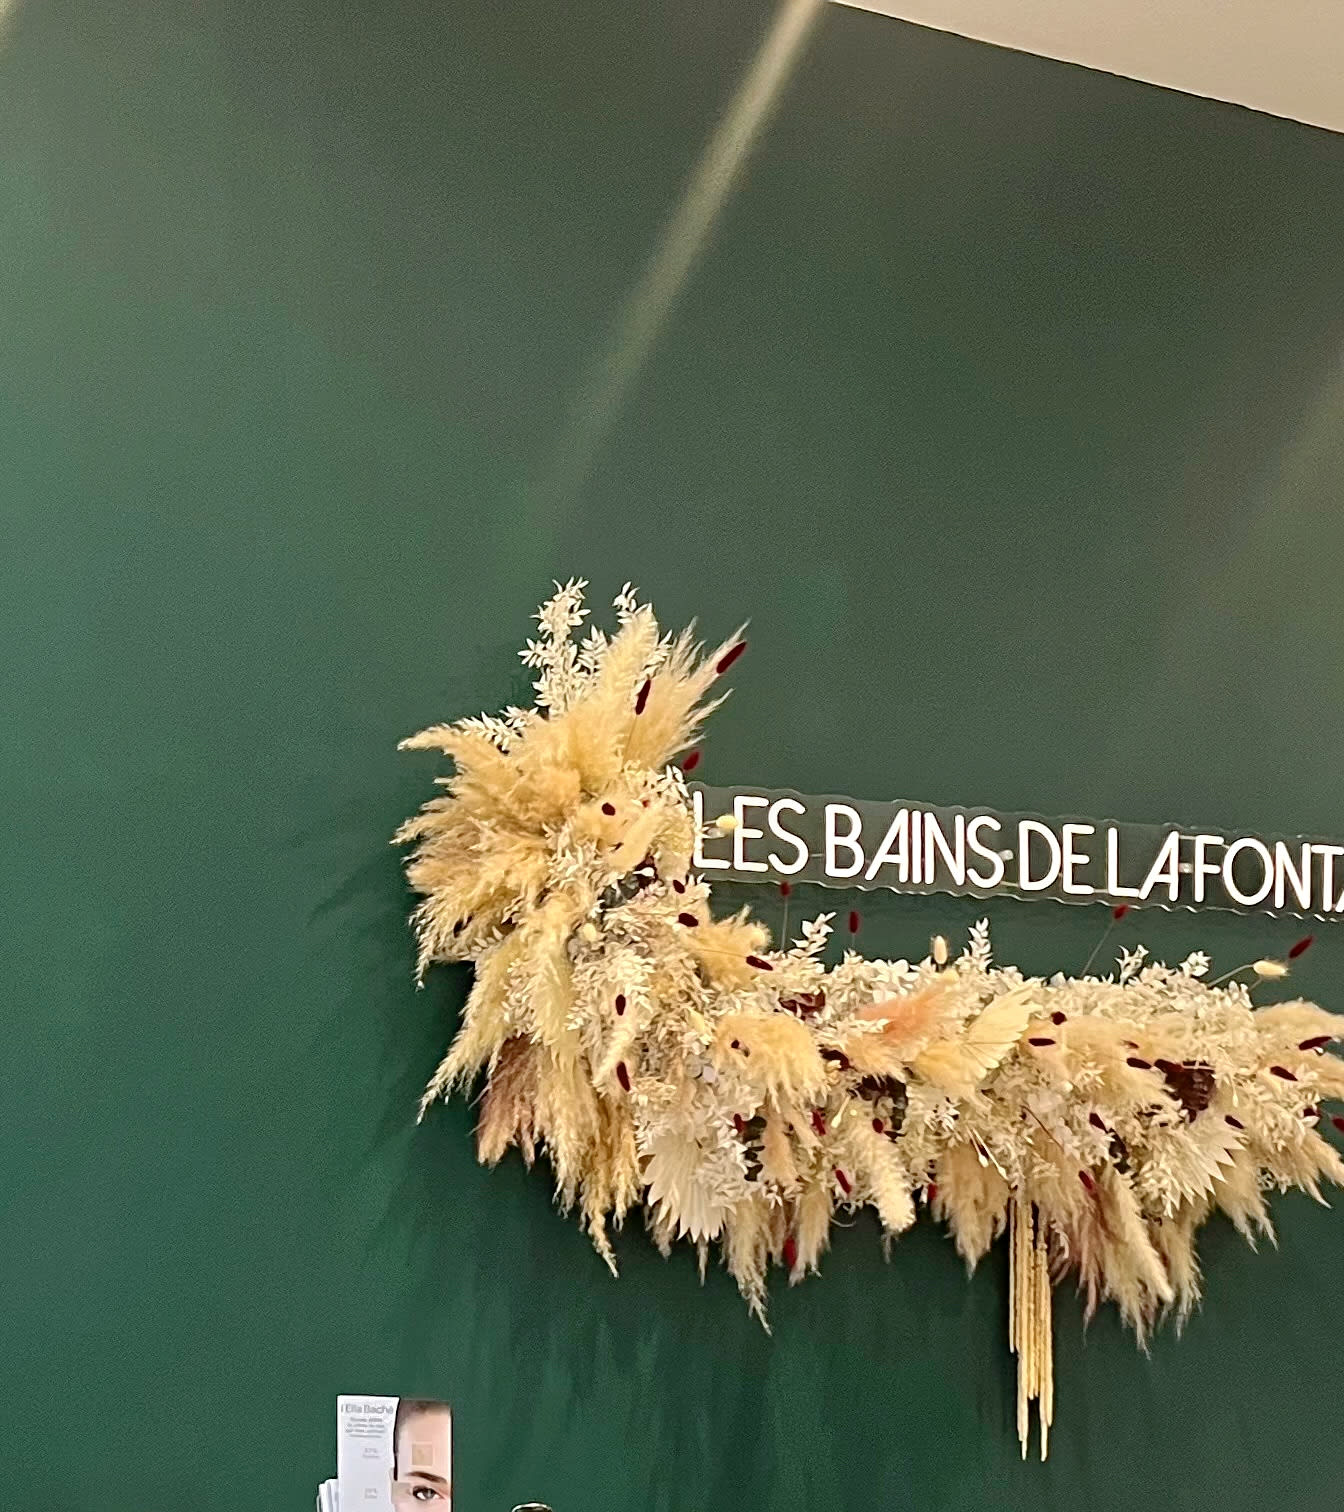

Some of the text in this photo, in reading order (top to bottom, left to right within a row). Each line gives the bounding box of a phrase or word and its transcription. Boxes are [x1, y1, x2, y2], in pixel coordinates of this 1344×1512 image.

[692, 790, 810, 876] LES
[824, 803, 1005, 889] BAINS
[1018, 820, 1096, 895] DE
